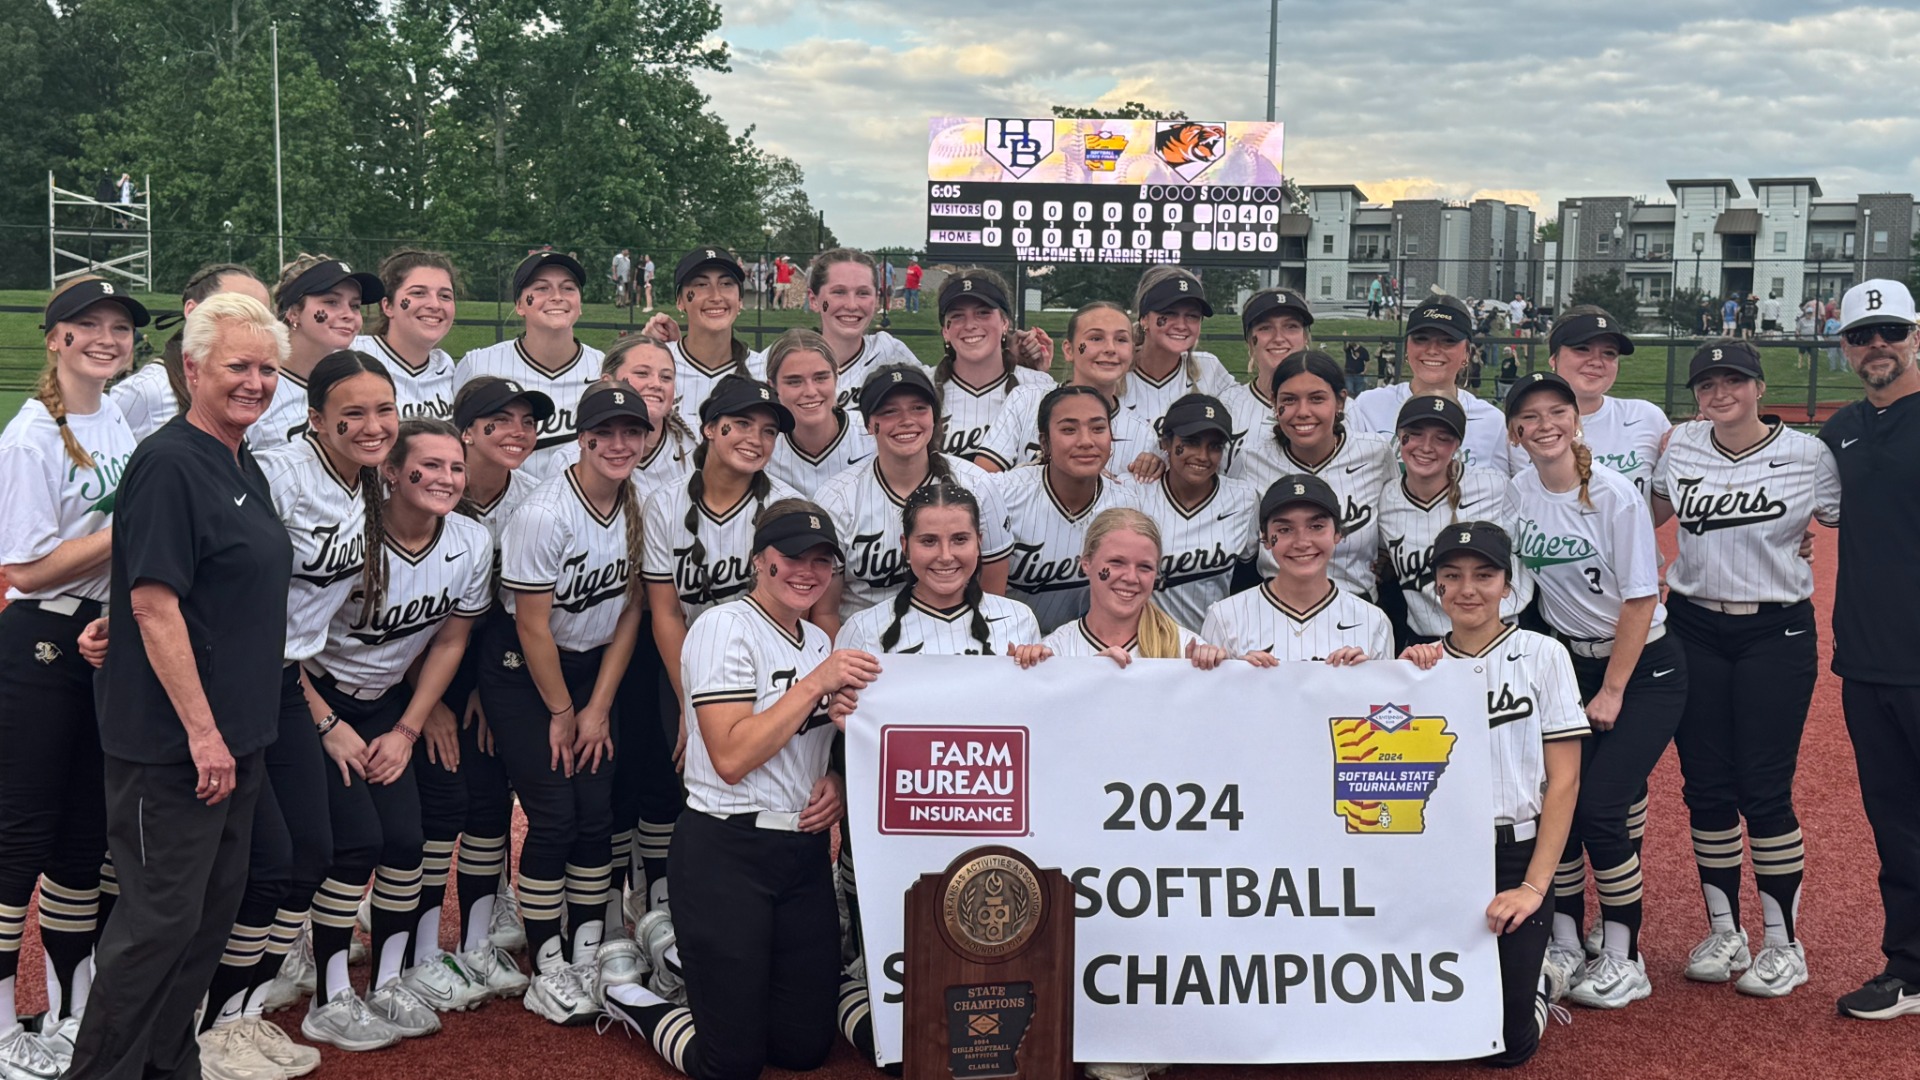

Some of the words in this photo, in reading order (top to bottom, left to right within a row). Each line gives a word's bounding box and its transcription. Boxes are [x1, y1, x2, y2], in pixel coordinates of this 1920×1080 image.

[931, 184, 961, 198] 6:05
[1200, 186, 1209, 201] S
[934, 204, 980, 215] VISITORS
[988, 204, 997, 217] 0
[1018, 205, 1027, 217] 0
[1048, 205, 1057, 218] 0
[1078, 206, 1087, 218] 0
[1107, 206, 1117, 219] 0
[1137, 207, 1147, 220] 0
[1168, 208, 1177, 220] 0
[1222, 208, 1231, 221] 0
[1243, 209, 1252, 221] 4
[1264, 209, 1273, 222] 0
[939, 231, 972, 242] HOME
[987, 231, 996, 244] 0
[1017, 232, 1026, 244] 0
[1047, 232, 1056, 245] 0
[1078, 233, 1084, 245] 1
[1107, 233, 1116, 246] 0
[1137, 233, 1146, 246] 0
[1222, 236, 1229, 248] 1
[1243, 236, 1251, 248] 5
[1263, 236, 1272, 249] 0
[1016, 247, 1077, 262] WELCOME
[1079, 248, 1095, 262] TO
[1098, 249, 1142, 263] FARRIS
[1145, 250, 1181, 264] FIELD
[100, 282, 115, 295] B
[962, 280, 973, 292] B
[1178, 280, 1189, 292] B
[1276, 293, 1287, 304] B
[1866, 290, 1883, 311] B
[1597, 317, 1607, 329] B
[1712, 349, 1724, 361] B
[613, 392, 625, 405] B
[760, 388, 770, 400] B
[1205, 406, 1215, 419] B
[1433, 399, 1445, 412] B
[1294, 484, 1306, 495] B
[1677, 476, 1787, 536] Tigers
[809, 515, 822, 530] B
[1459, 532, 1472, 544] B
[1518, 517, 1600, 576] Tigers
[300, 522, 365, 588] Tiger
[851, 529, 903, 588] Tig
[673, 545, 752, 605] Tiger
[1008, 542, 1088, 594] Tiger
[553, 551, 630, 614] Tiger
[1584, 567, 1604, 595] 3
[930, 741, 1014, 768] FARM
[1378, 752, 1403, 761] 2024
[895, 769, 1014, 796] BUREAU
[1338, 771, 1398, 782] SOFTBALL
[1399, 770, 1436, 781] STATE
[1348, 782, 1430, 792] TOURNAMENT
[909, 805, 1014, 822] INSURANCE
[1102, 782, 1245, 831] 2024
[946, 872, 966, 922] ARKANSAS
[966, 858, 1012, 876] ACTIVITIES
[1012, 864, 1040, 917] ASSOCIATION
[1070, 867, 1376, 918] SOFTBALL
[964, 941, 1005, 954] FOUNDED
[1082, 951, 1465, 1006] CHAMPIONS
[968, 986, 1006, 998] STATE
[953, 997, 1025, 1012] CHAMPIONS
